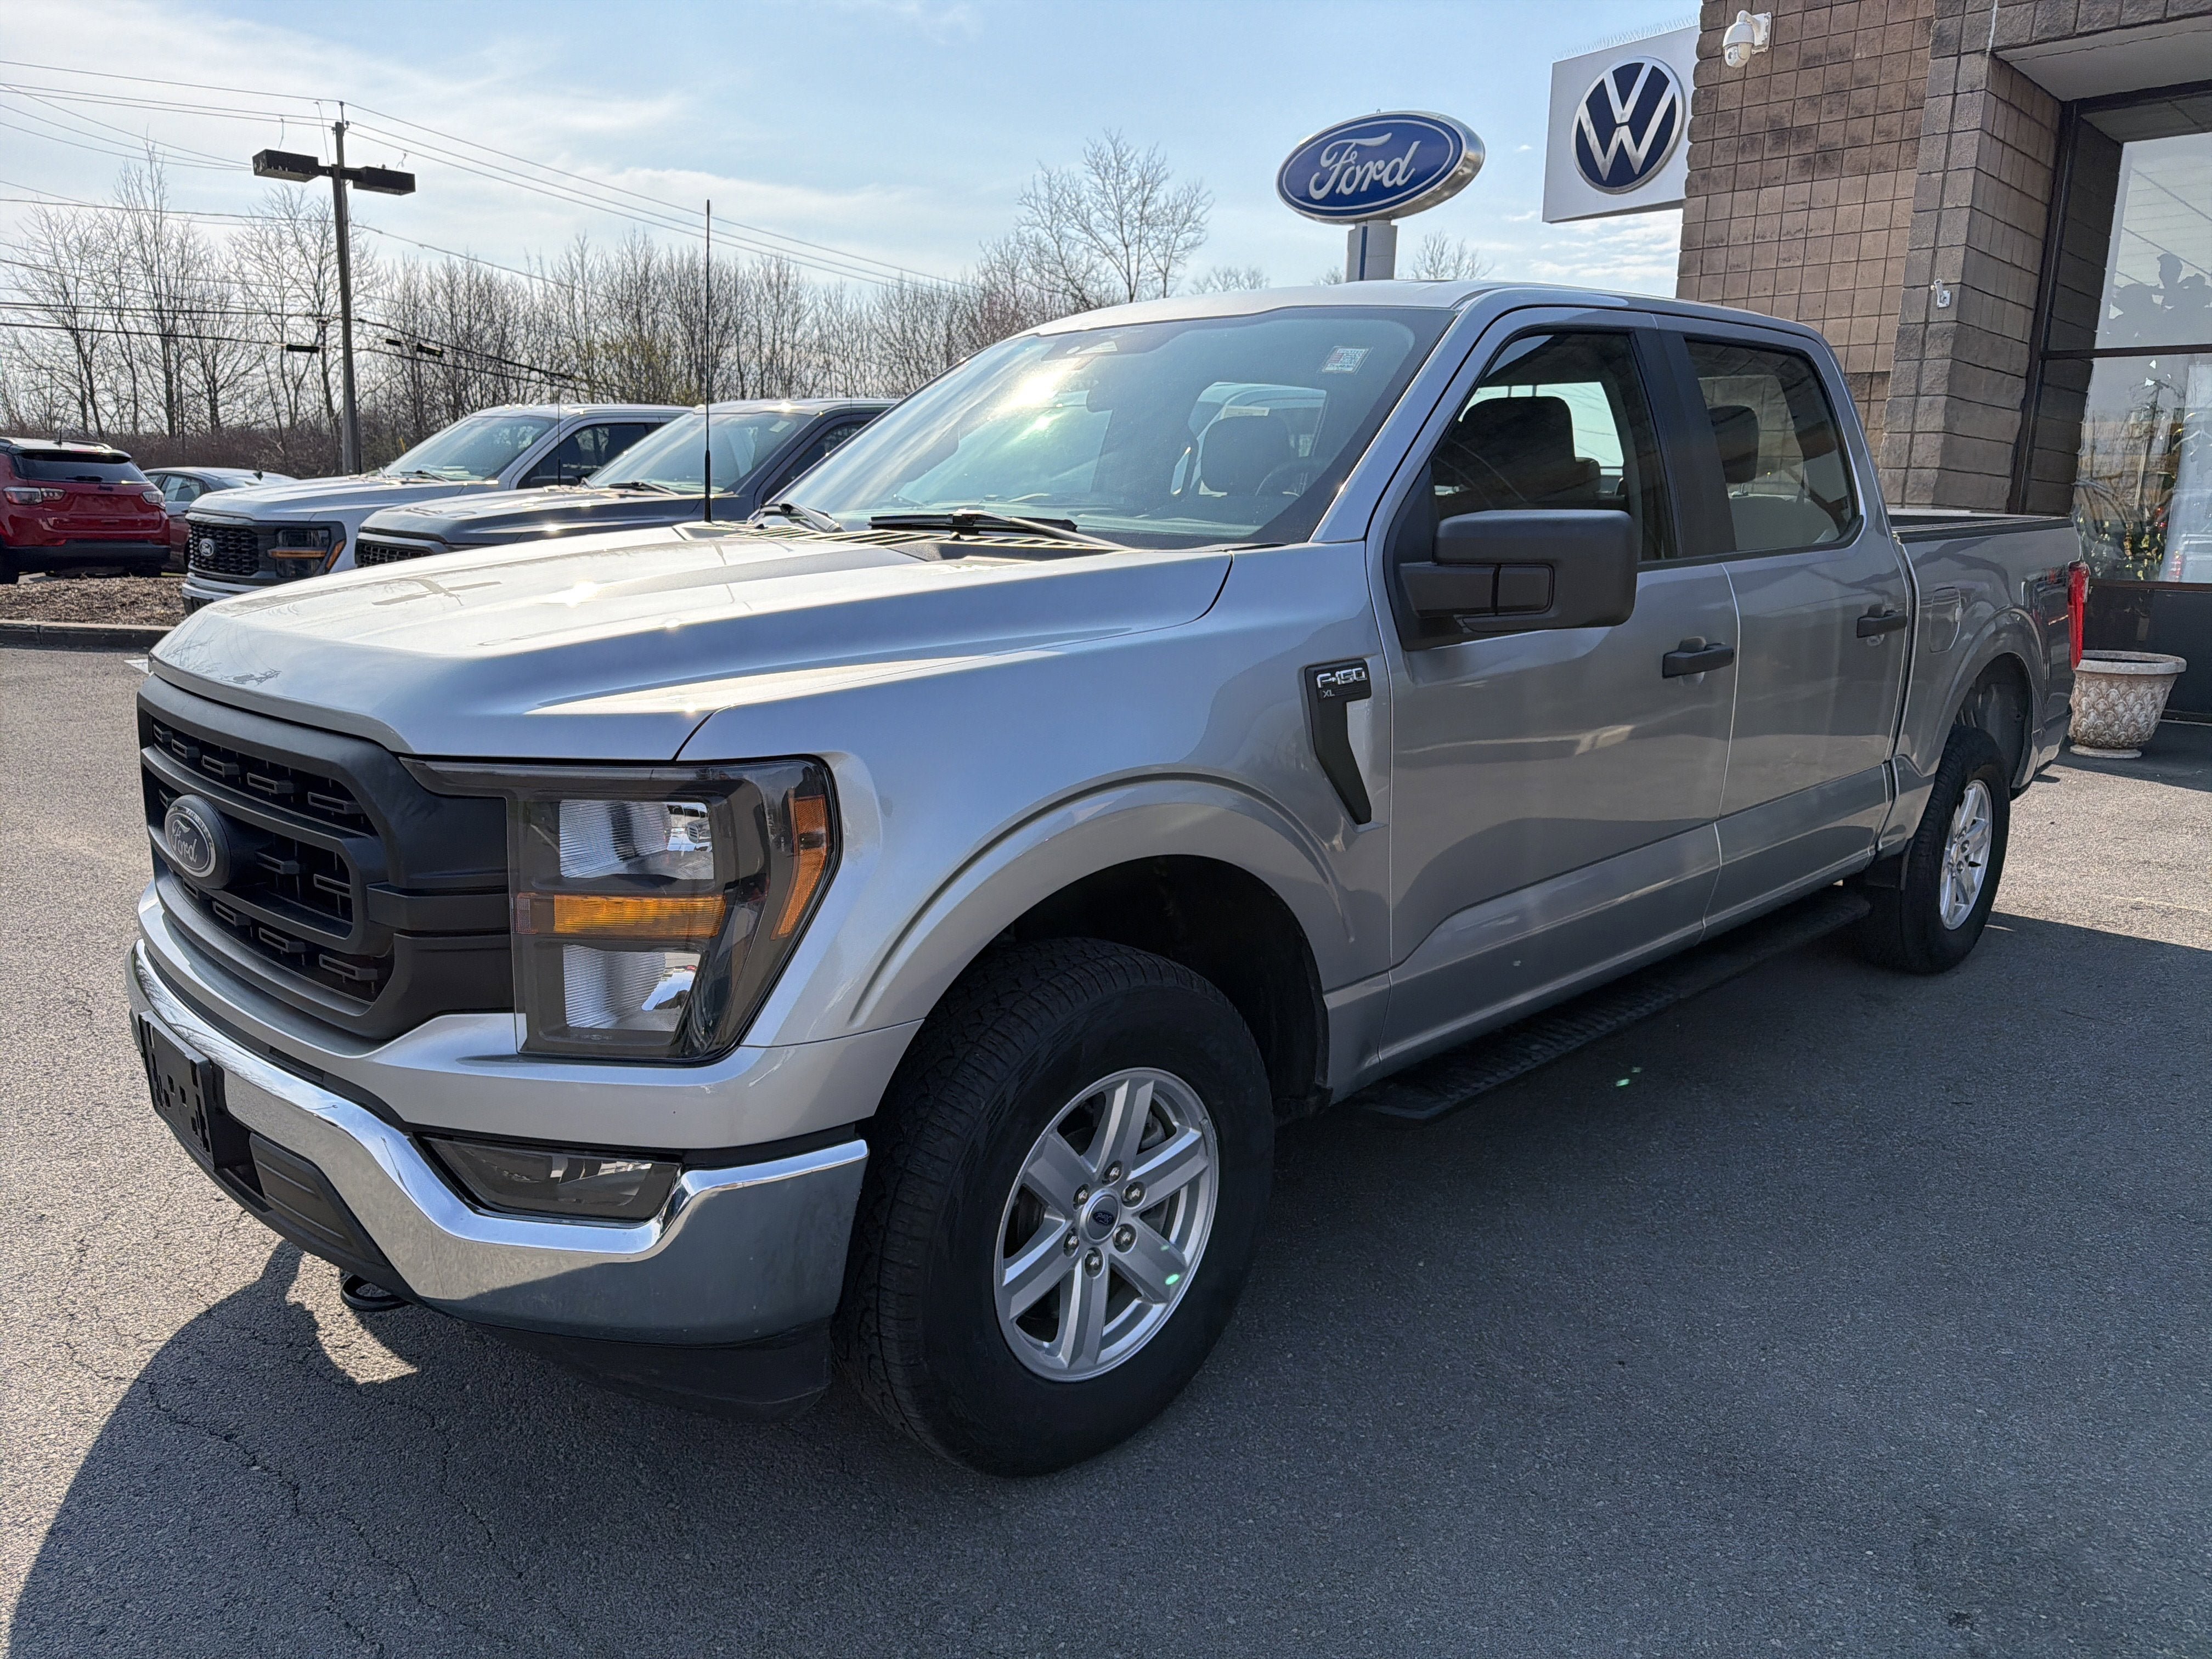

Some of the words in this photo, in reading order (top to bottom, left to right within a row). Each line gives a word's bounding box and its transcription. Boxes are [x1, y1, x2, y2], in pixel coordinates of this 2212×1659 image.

[1576, 60, 1678, 182] VW
[1309, 132, 1421, 200] Ford
[1317, 667, 1367, 689] F-150
[1322, 689, 1335, 698] XL
[171, 819, 198, 863] Ford
